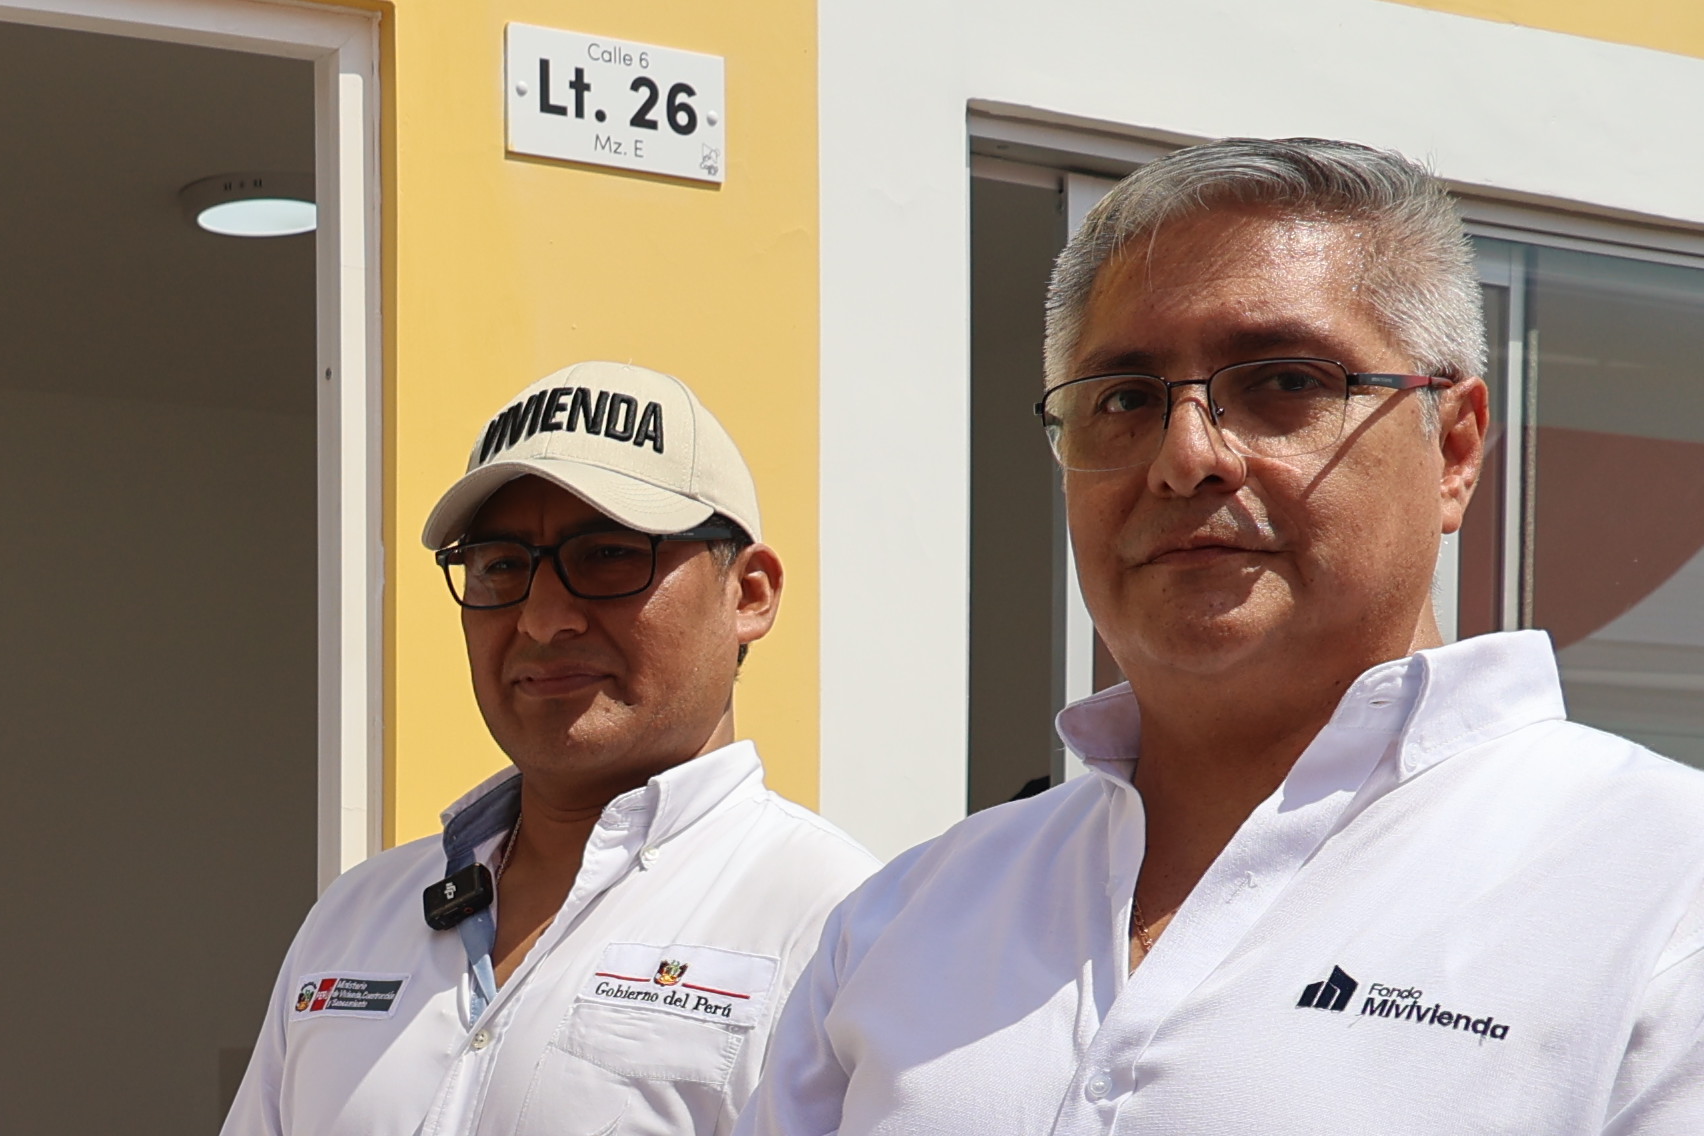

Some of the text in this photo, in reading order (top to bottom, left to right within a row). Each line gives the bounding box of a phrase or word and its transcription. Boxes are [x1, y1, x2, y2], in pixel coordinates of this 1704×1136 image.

[587, 42, 650, 69] Calle 6
[539, 57, 698, 136] Lt. 26
[594, 133, 645, 158] Mz. E
[595, 981, 732, 1019] Gobierno del Perú
[1368, 982, 1423, 1000] Fondo
